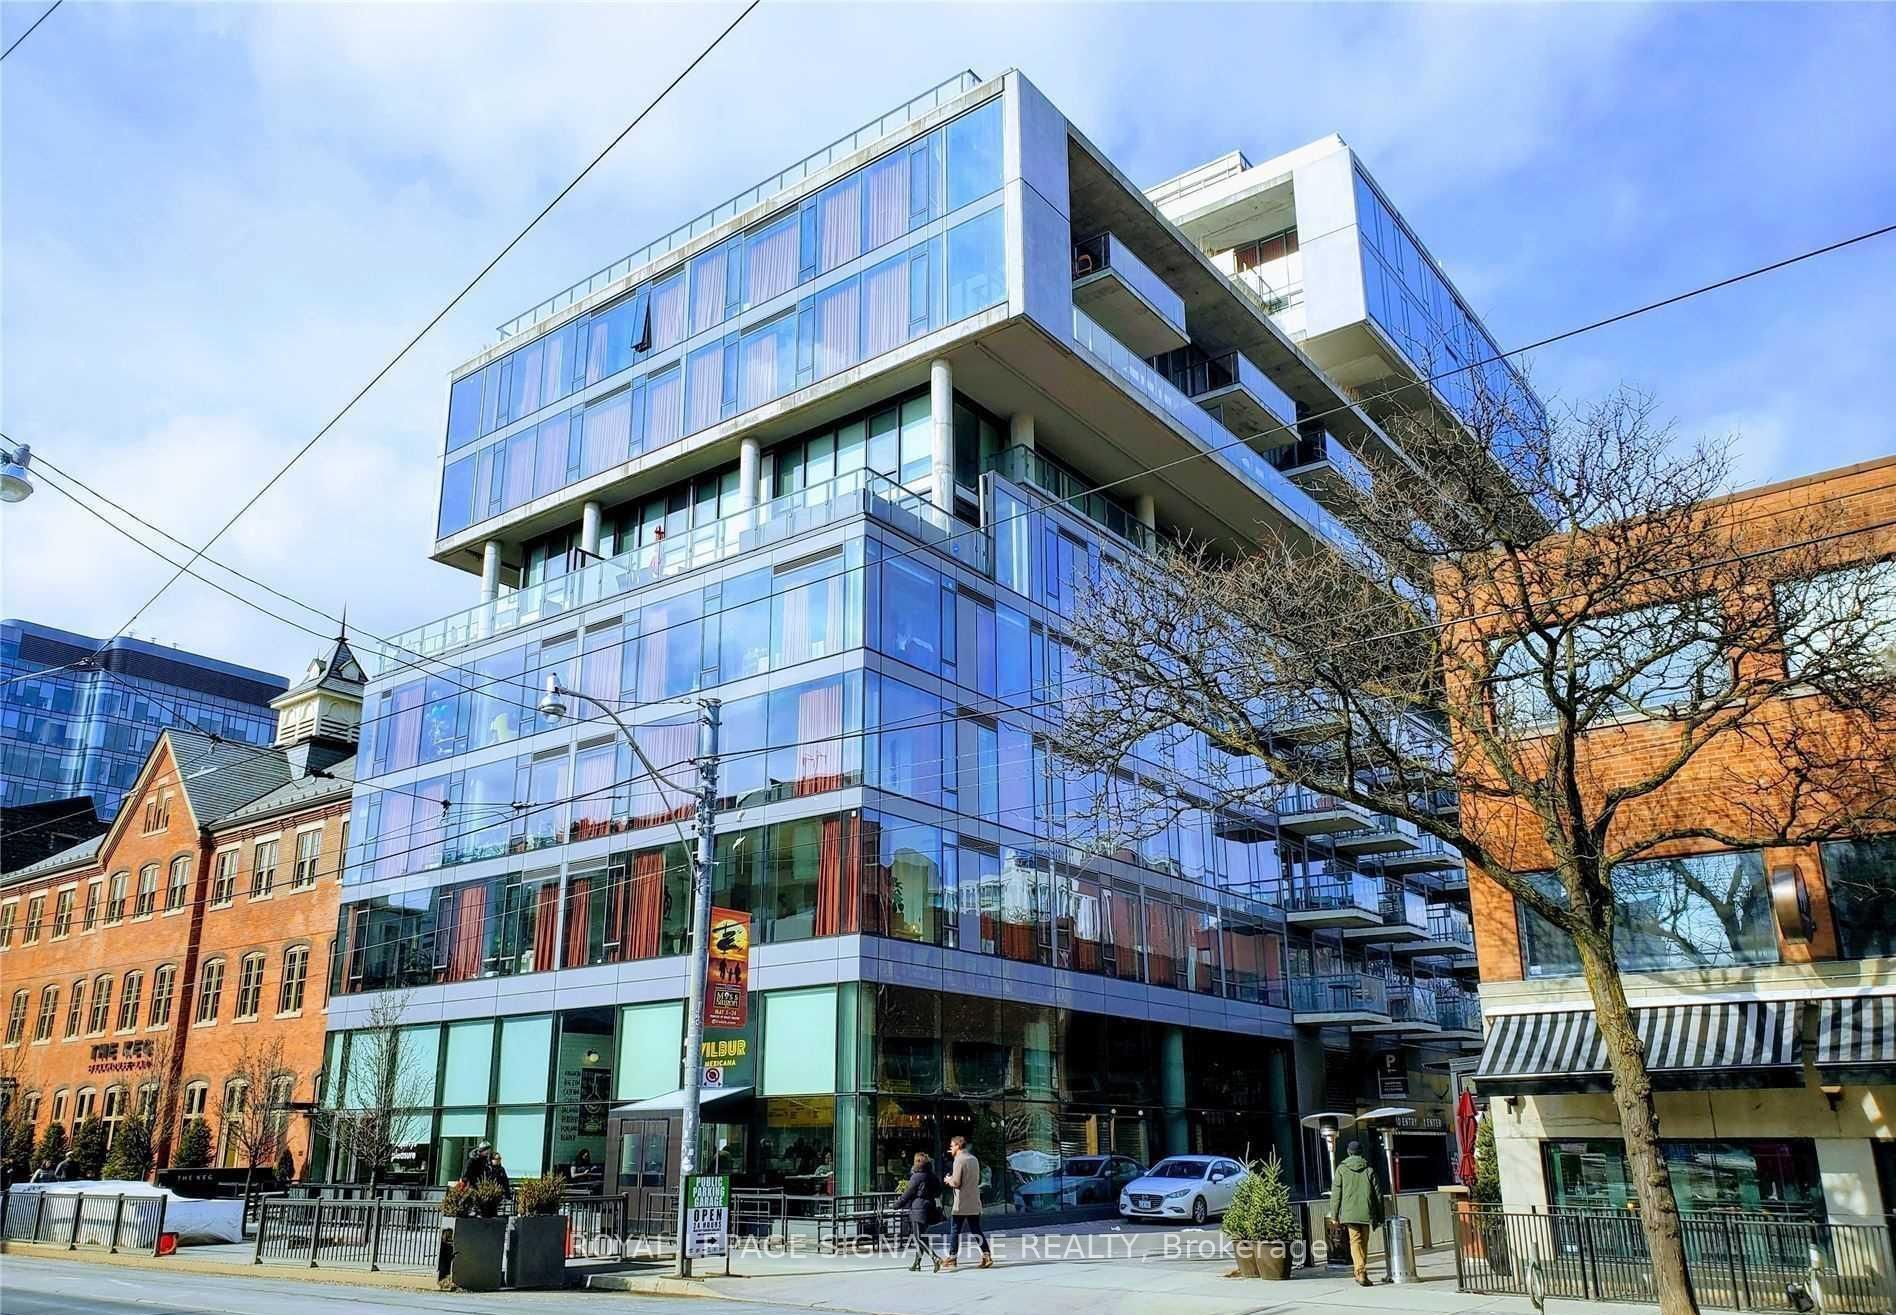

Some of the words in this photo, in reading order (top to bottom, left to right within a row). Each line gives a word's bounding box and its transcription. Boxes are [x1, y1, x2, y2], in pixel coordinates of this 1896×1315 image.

[696, 1176, 723, 1187] PUBLIC
[693, 1186, 725, 1197] PARKING
[695, 1197, 723, 1207] GARAGE
[694, 1209, 722, 1222] OPEN
